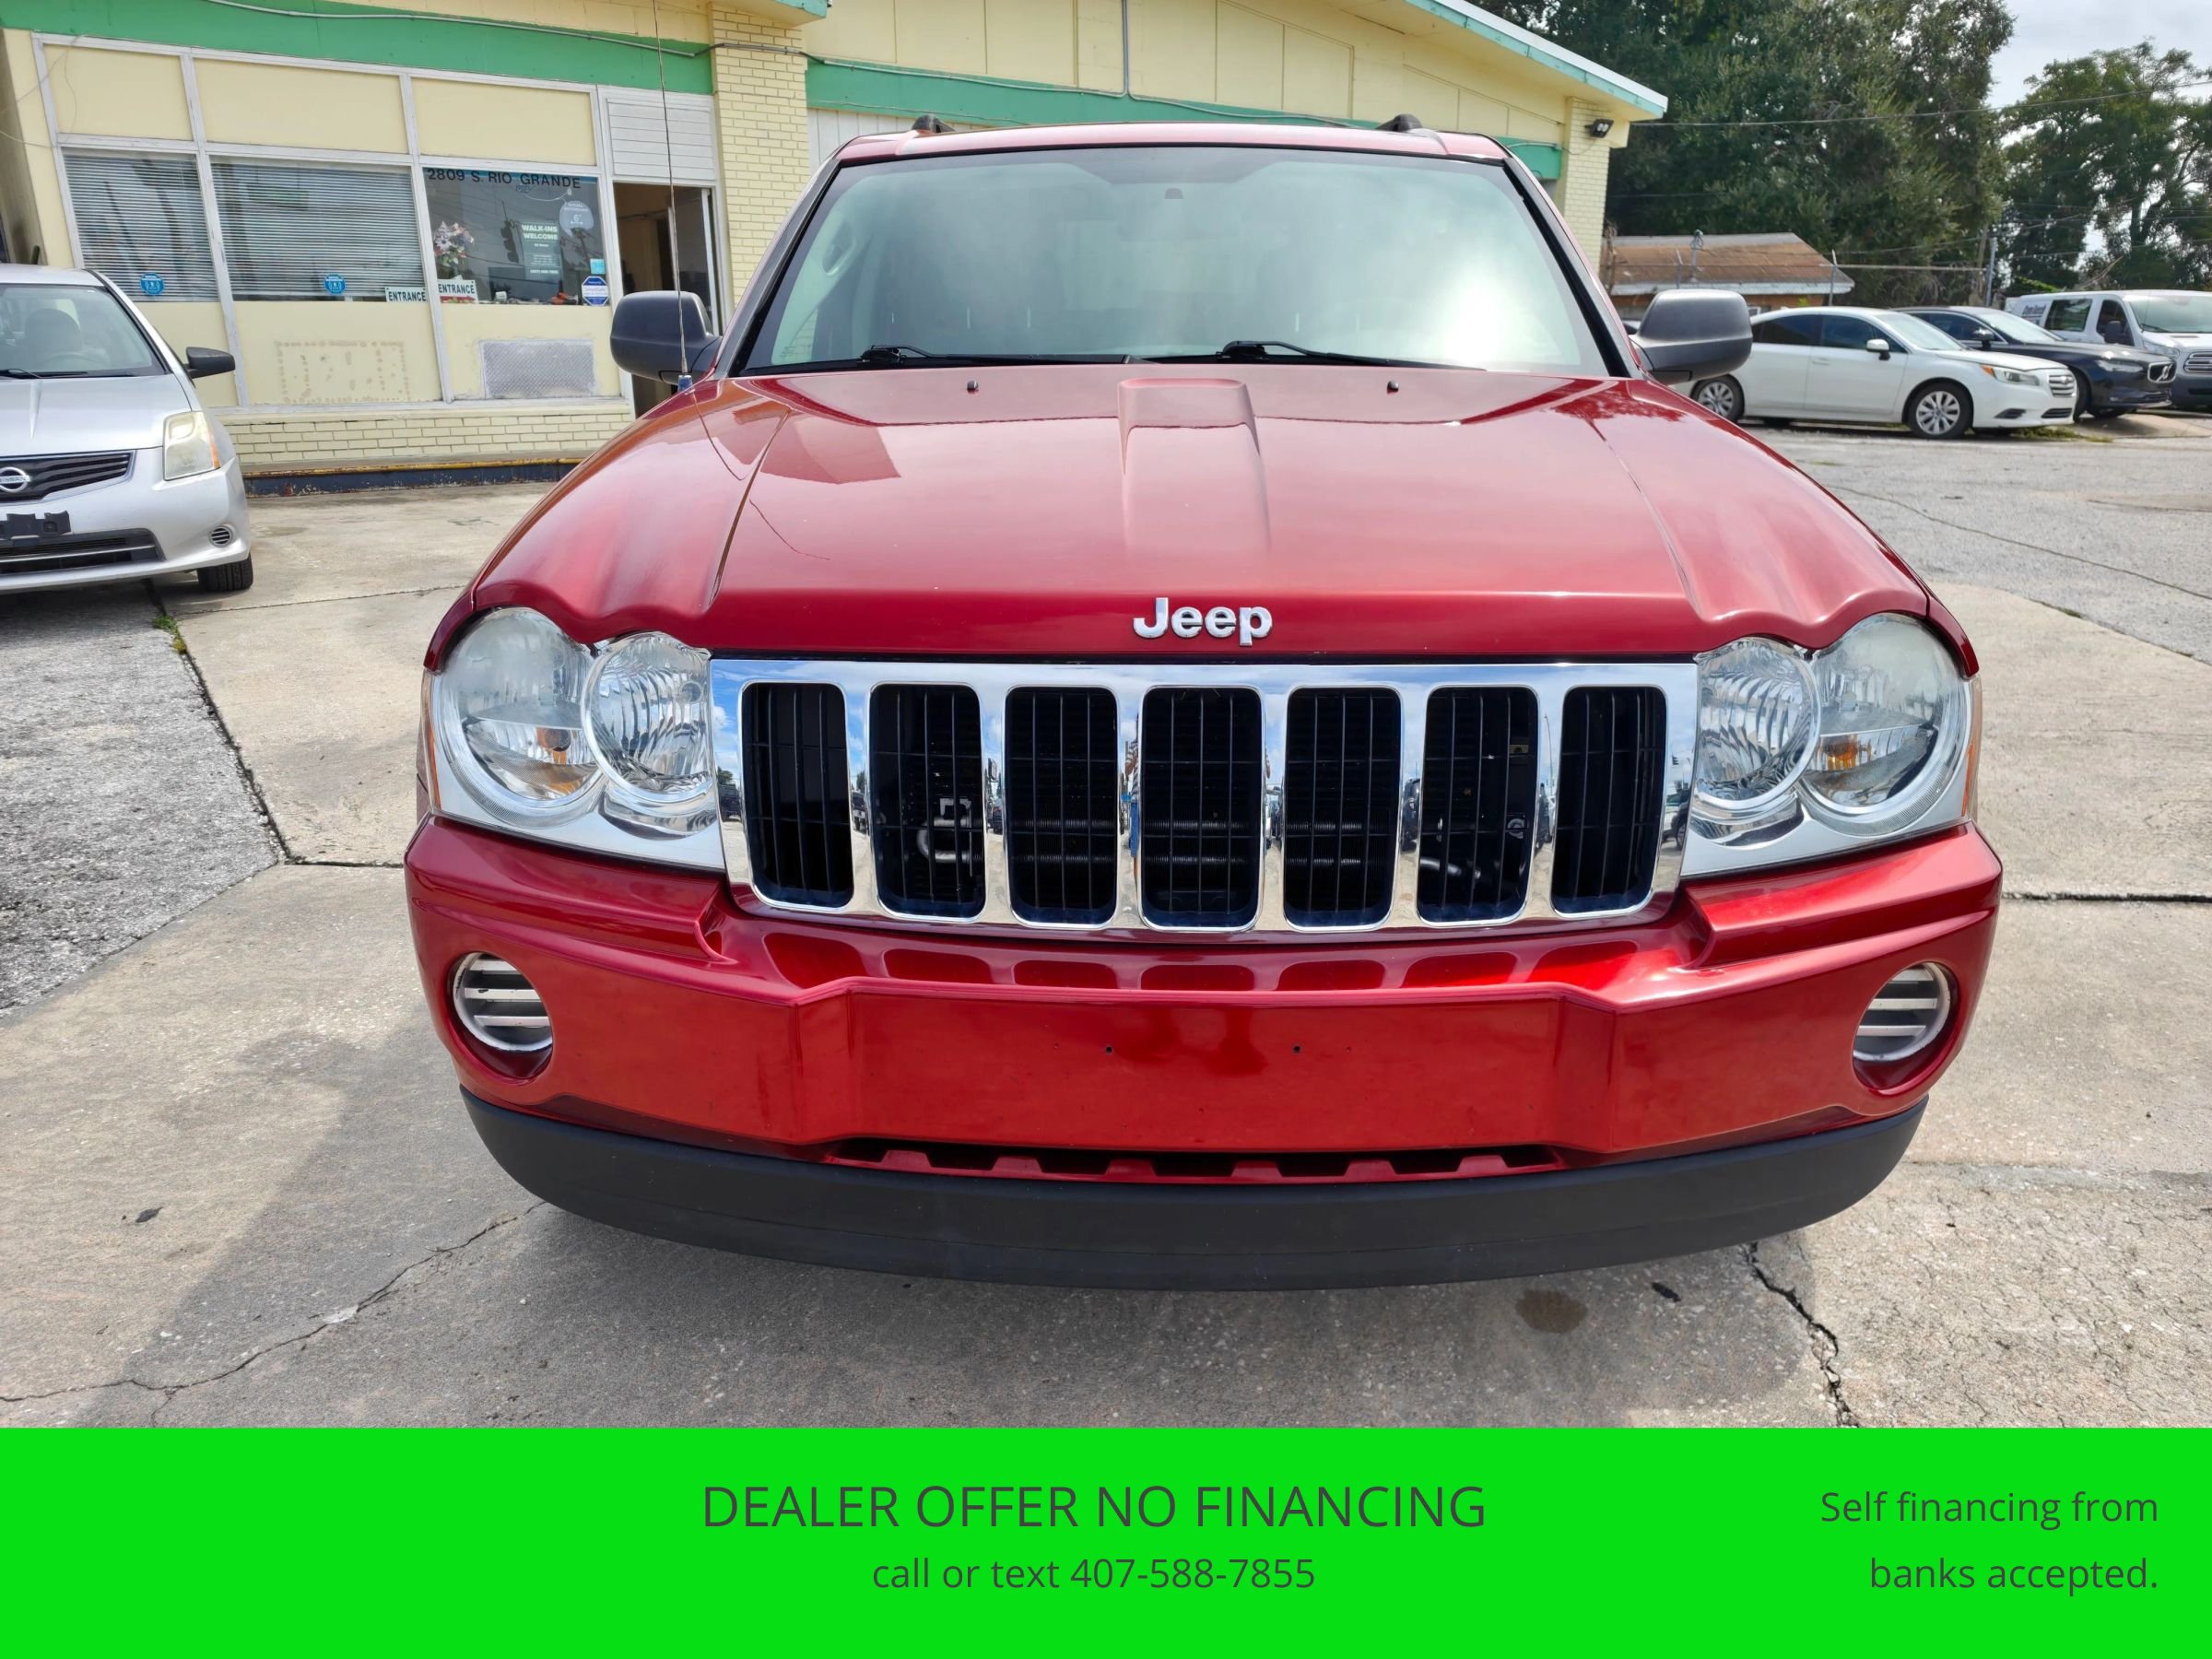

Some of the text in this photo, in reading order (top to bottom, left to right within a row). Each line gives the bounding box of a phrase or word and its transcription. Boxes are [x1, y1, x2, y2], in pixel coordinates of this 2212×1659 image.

[428, 169, 582, 188] 2809 S. RIO GRANDE
[388, 291, 427, 301] ENTRANCE
[438, 284, 475, 294] ENTRANCE
[1133, 597, 1272, 646] Jeep
